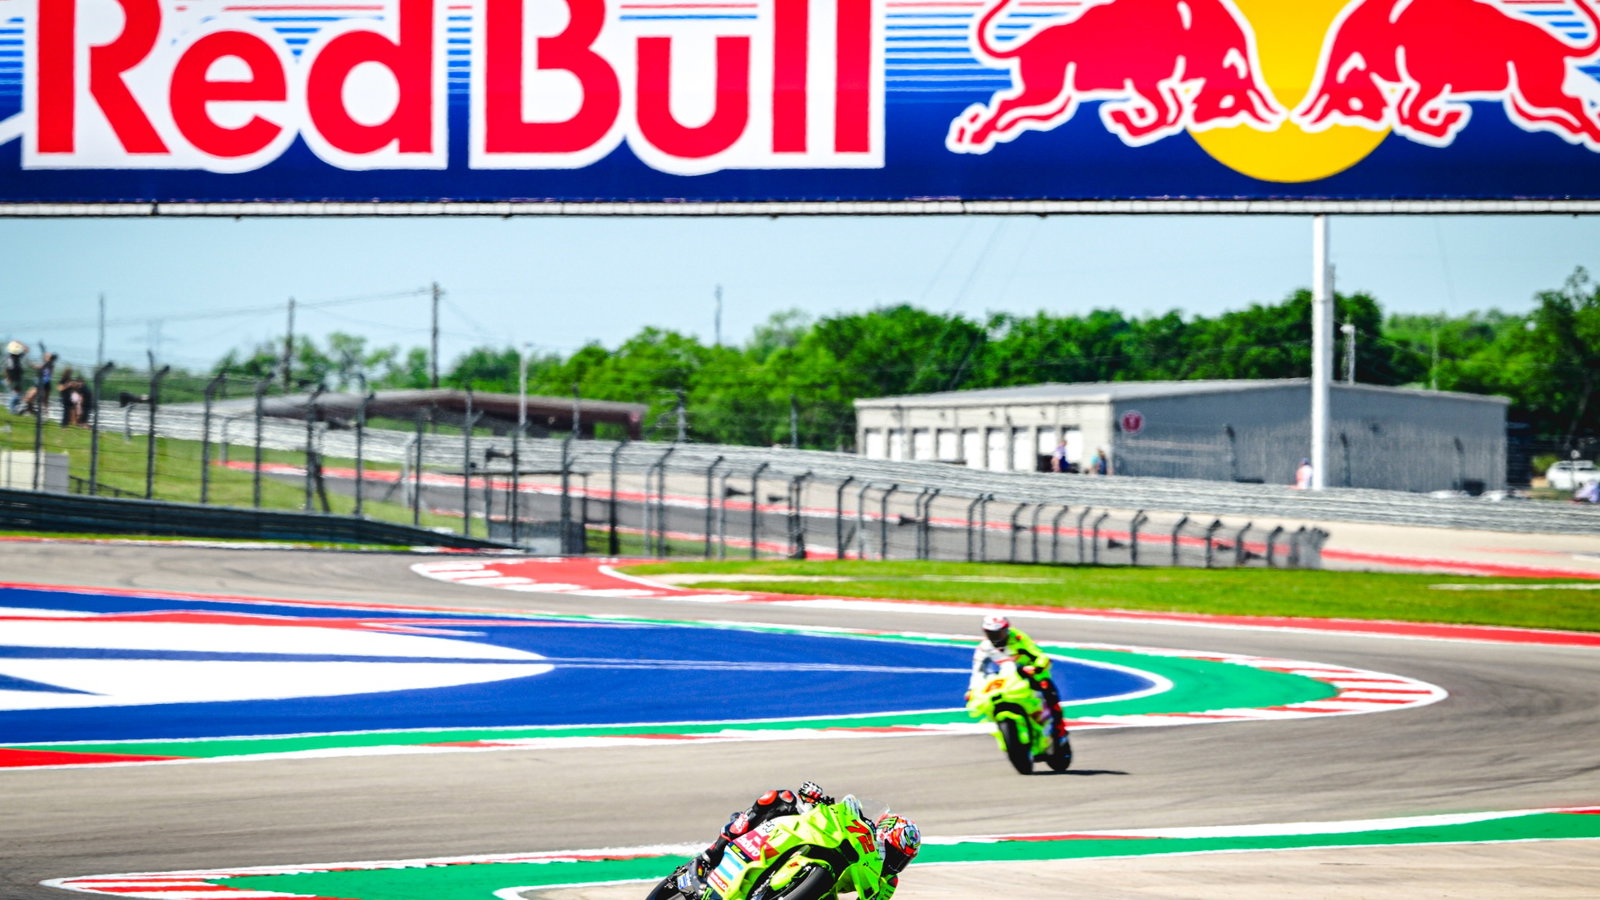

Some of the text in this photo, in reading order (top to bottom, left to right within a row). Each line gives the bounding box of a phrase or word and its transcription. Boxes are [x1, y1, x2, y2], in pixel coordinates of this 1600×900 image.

[36, 0, 872, 160] Red Bull
[845, 819, 876, 854] 72
